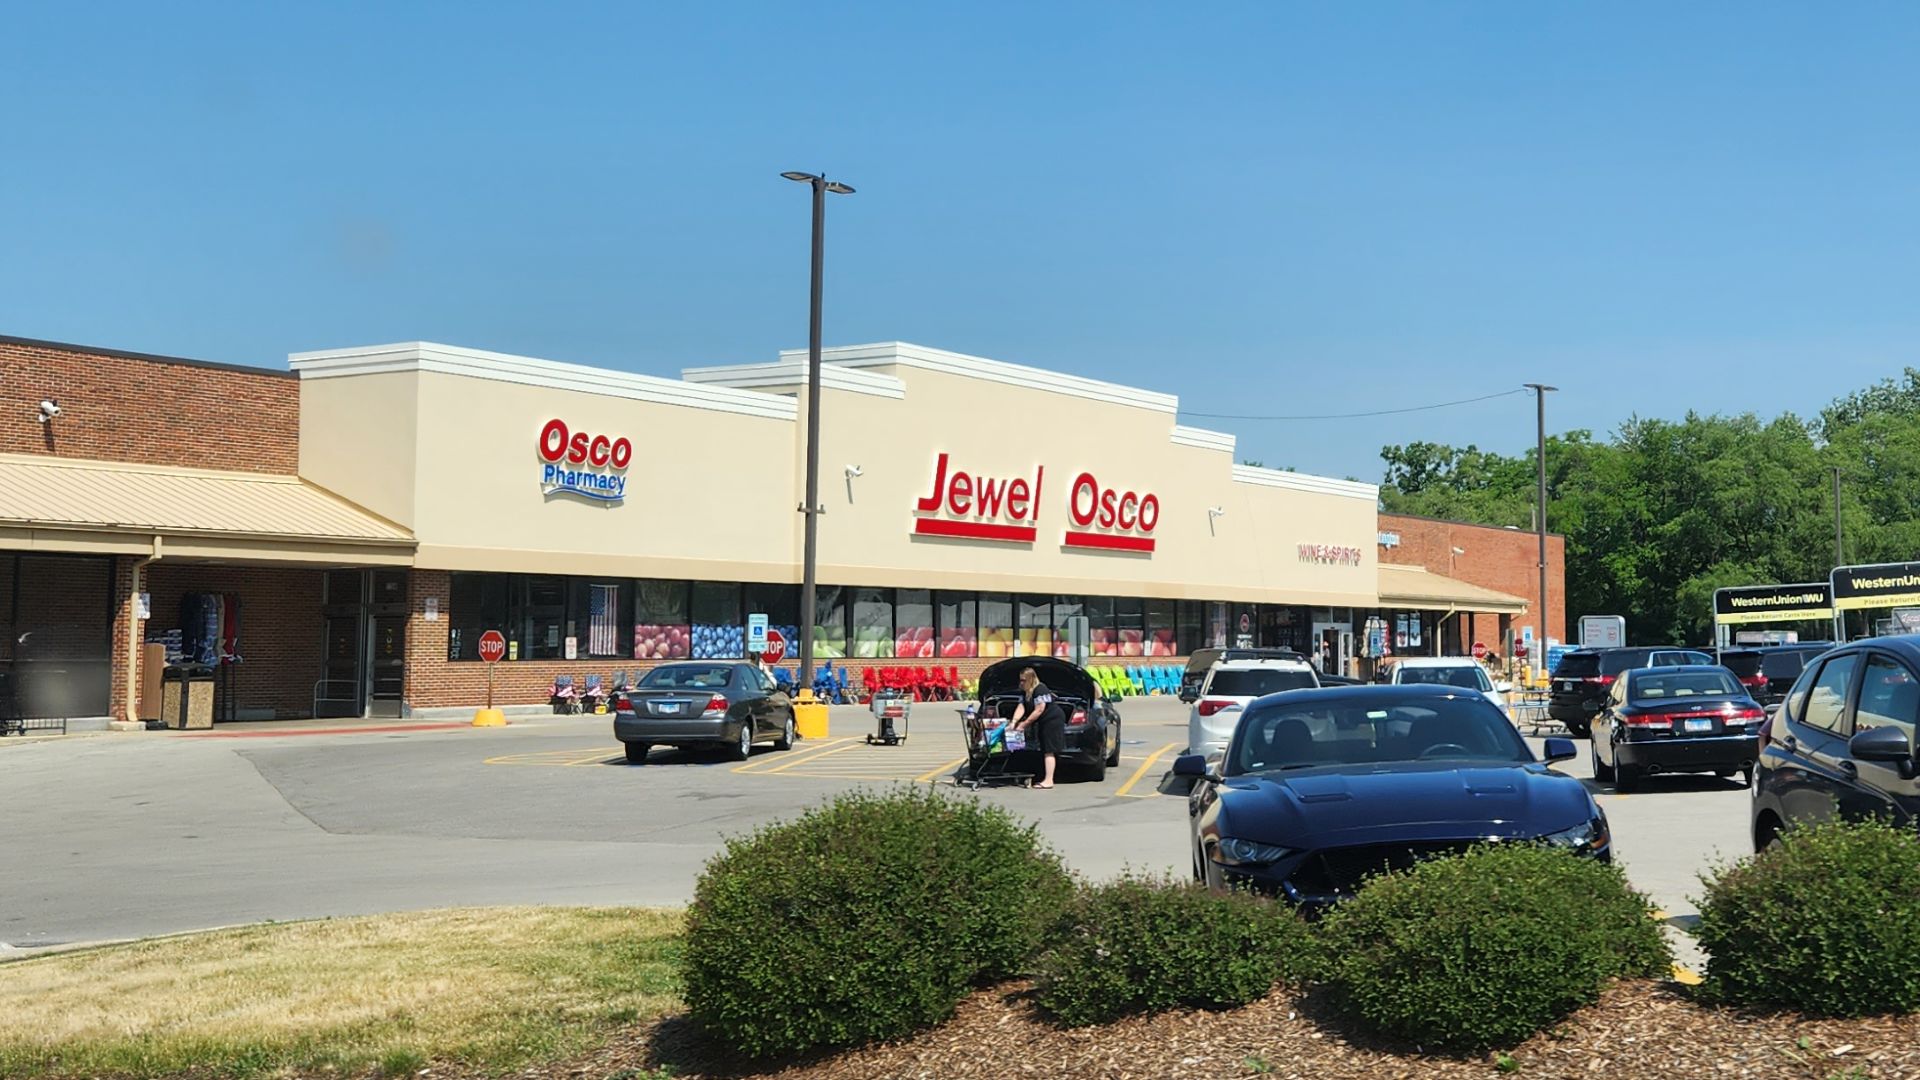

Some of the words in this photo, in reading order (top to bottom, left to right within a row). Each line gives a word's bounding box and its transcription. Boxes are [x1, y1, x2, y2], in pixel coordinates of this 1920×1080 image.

[540, 419, 631, 468] Osco
[544, 464, 626, 494] Pharmacy
[918, 453, 1044, 521] Jewel
[1071, 472, 1159, 532] Osco
[481, 640, 503, 654] STOP
[767, 641, 784, 654] TOP
